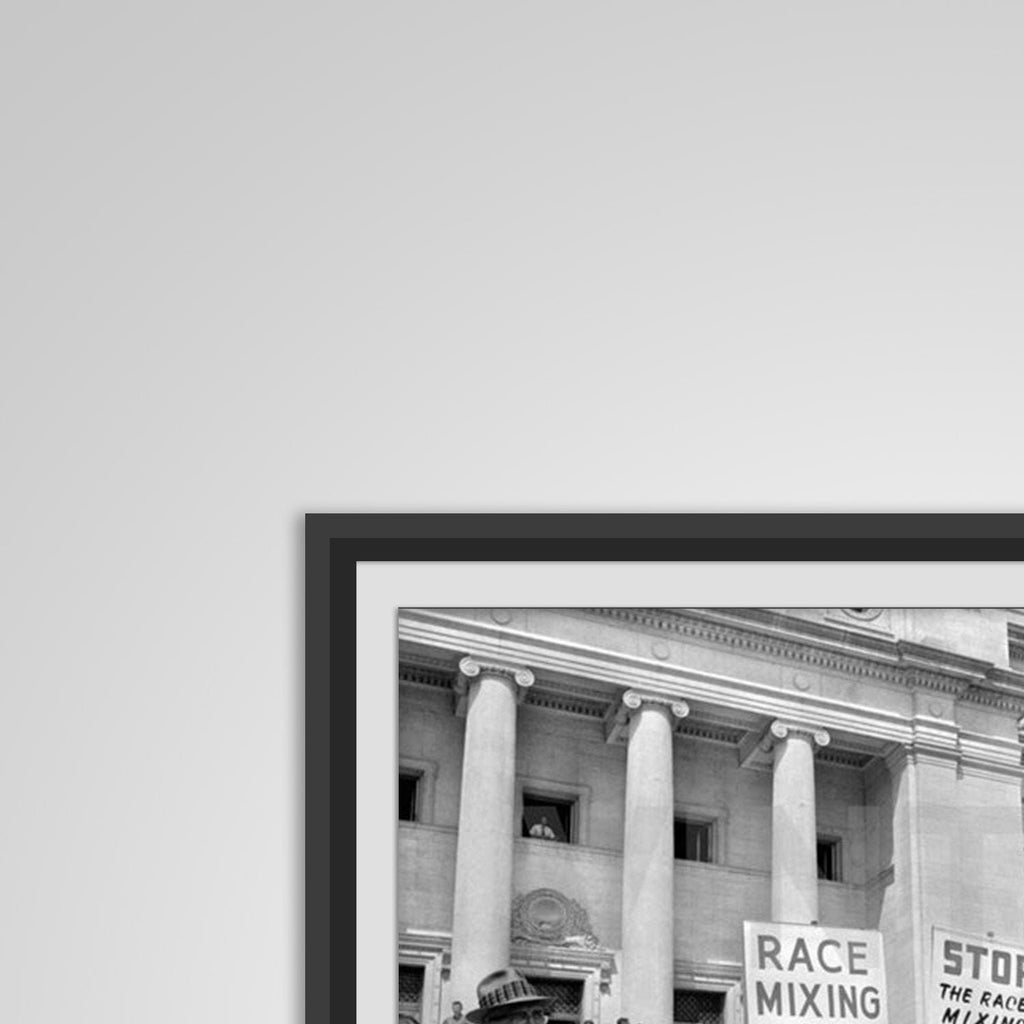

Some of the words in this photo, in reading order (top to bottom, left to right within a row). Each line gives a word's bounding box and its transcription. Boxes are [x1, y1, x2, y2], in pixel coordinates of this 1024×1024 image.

[756, 934, 869, 976] RACE
[755, 980, 881, 1020] MIXING
[939, 982, 973, 1004] THE
